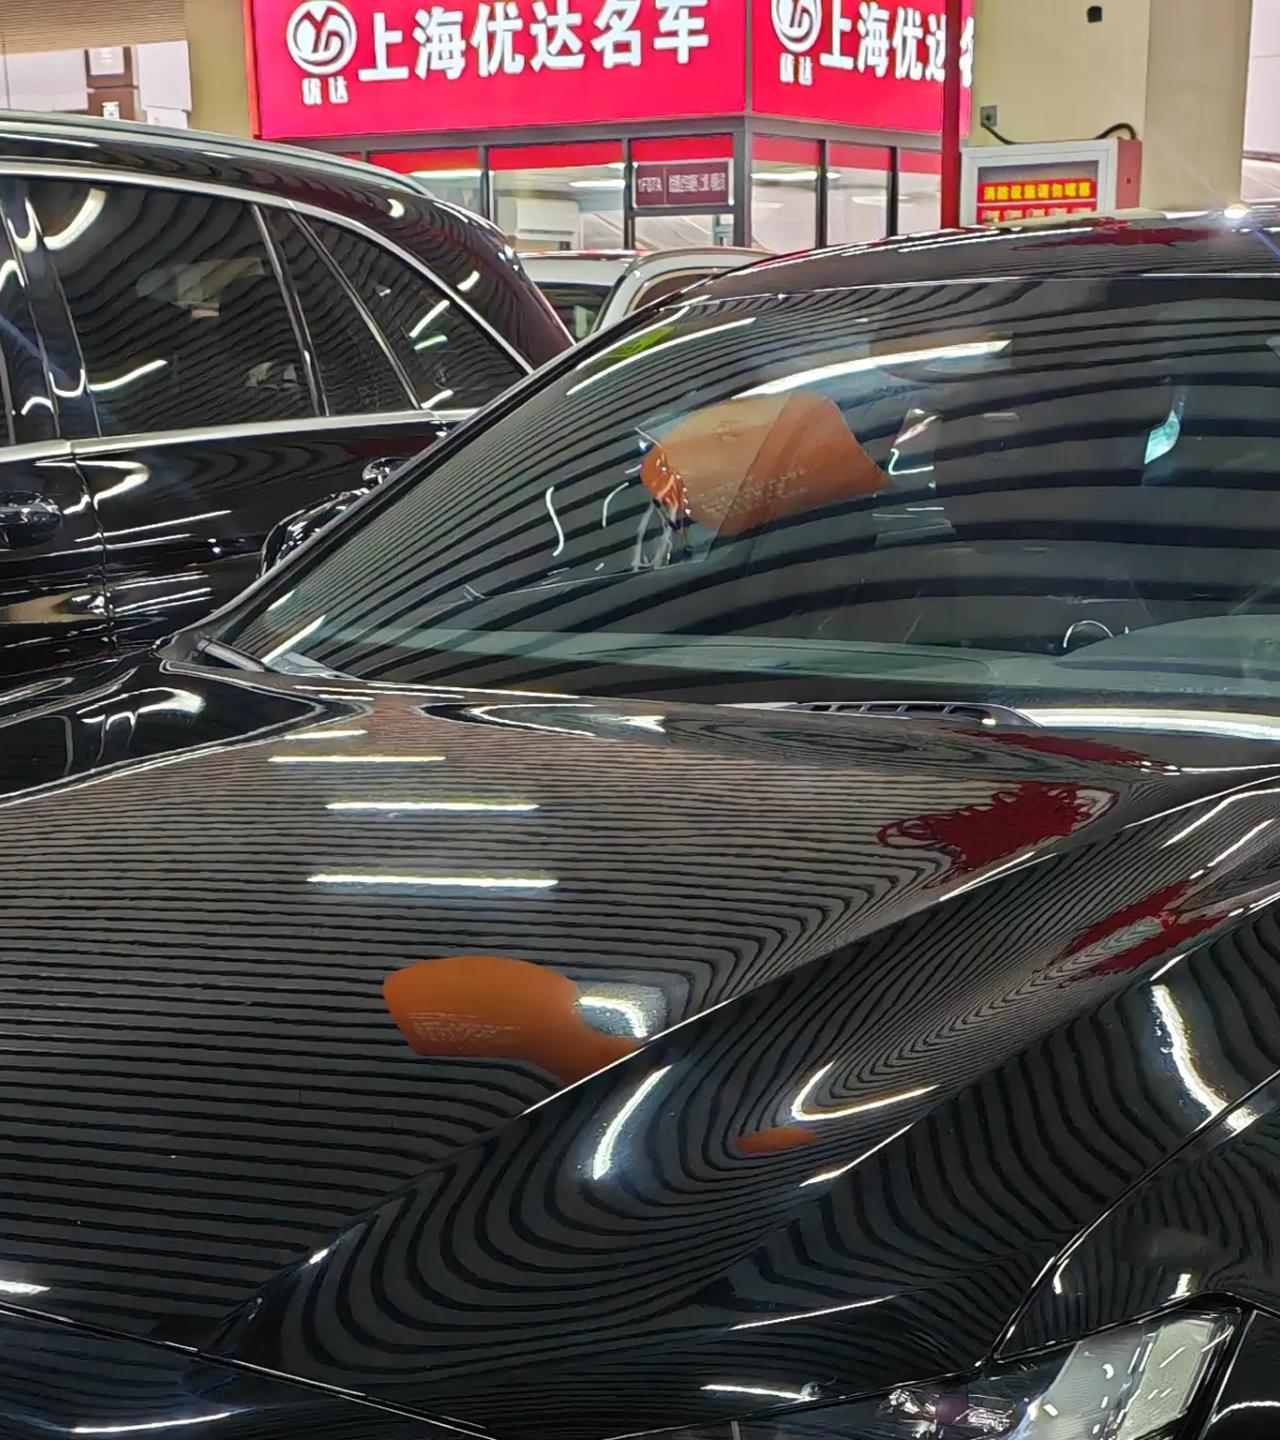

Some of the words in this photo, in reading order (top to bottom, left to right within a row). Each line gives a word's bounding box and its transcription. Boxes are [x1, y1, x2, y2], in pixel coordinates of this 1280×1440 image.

[357, 0, 709, 82] 上海优达名车
